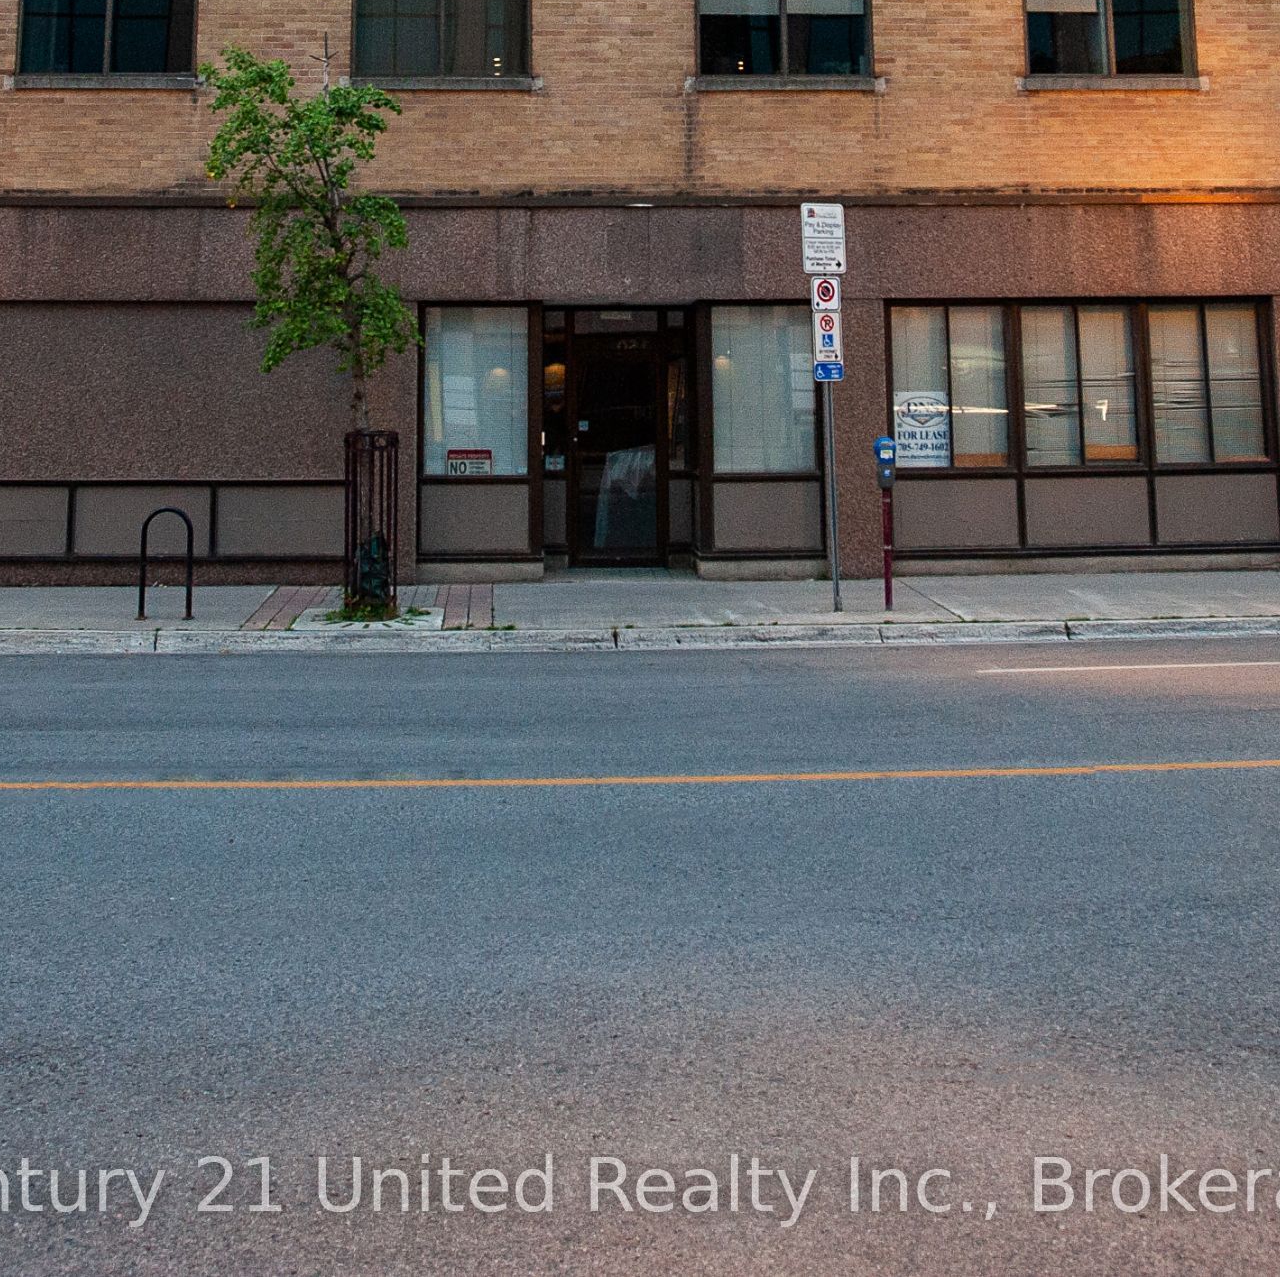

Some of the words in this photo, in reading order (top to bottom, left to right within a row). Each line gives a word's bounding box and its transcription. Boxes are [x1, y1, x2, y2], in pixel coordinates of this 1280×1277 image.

[897, 430, 918, 440] FOR
[919, 430, 949, 440] LEASE
[450, 461, 468, 474] NO
